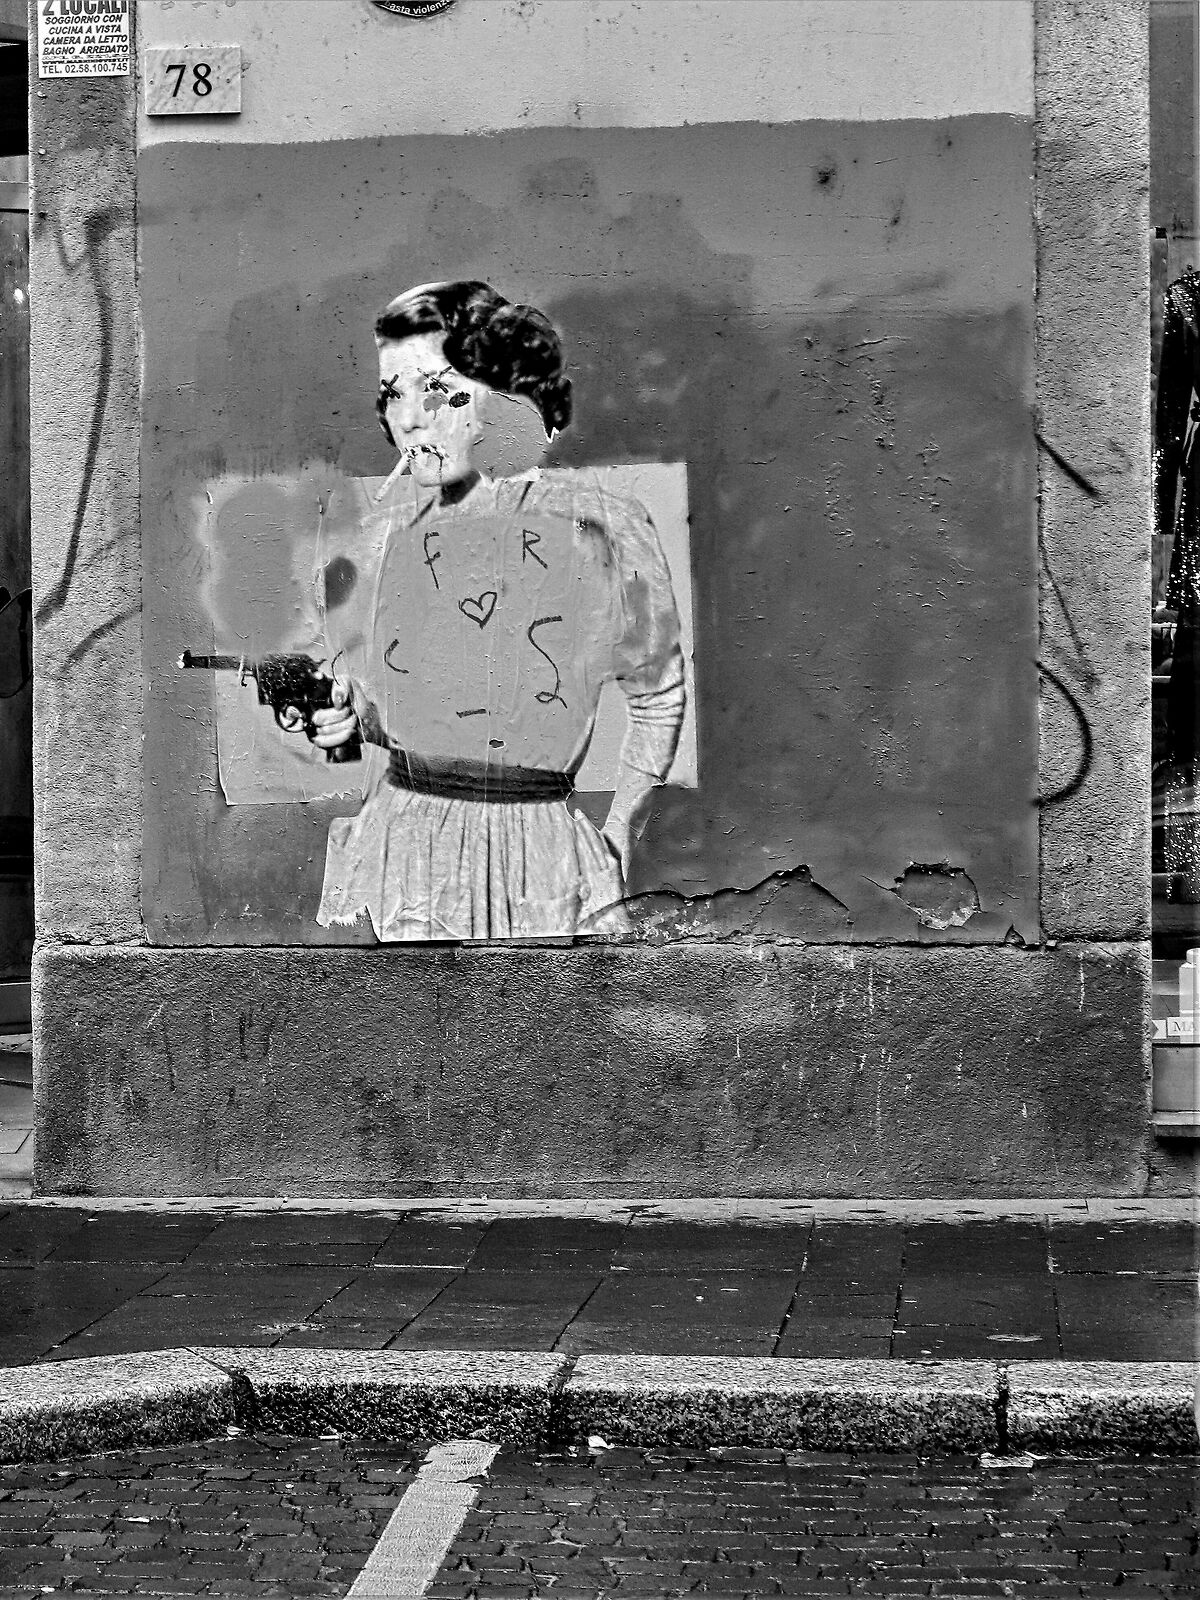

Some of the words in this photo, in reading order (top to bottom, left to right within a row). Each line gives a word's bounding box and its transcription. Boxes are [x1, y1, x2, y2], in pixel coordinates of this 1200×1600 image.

[60, 0, 128, 15] LOCALI
[44, 15, 100, 25] SOGGIORNO
[102, 14, 123, 23] CON
[48, 26, 83, 35] CUCINA
[85, 25, 93, 34] A
[96, 25, 121, 33] VISTA
[43, 36, 81, 45] CAMERA
[83, 35, 96, 44] DA
[98, 35, 128, 43] LETTO
[43, 46, 75, 55] BAGNO
[79, 45, 128, 54] ARREDATO
[42, 65, 63, 74] TEL.
[65, 63, 128, 74] 02.58.100.745
[165, 62, 213, 98] 78
[522, 529, 548, 569] R
